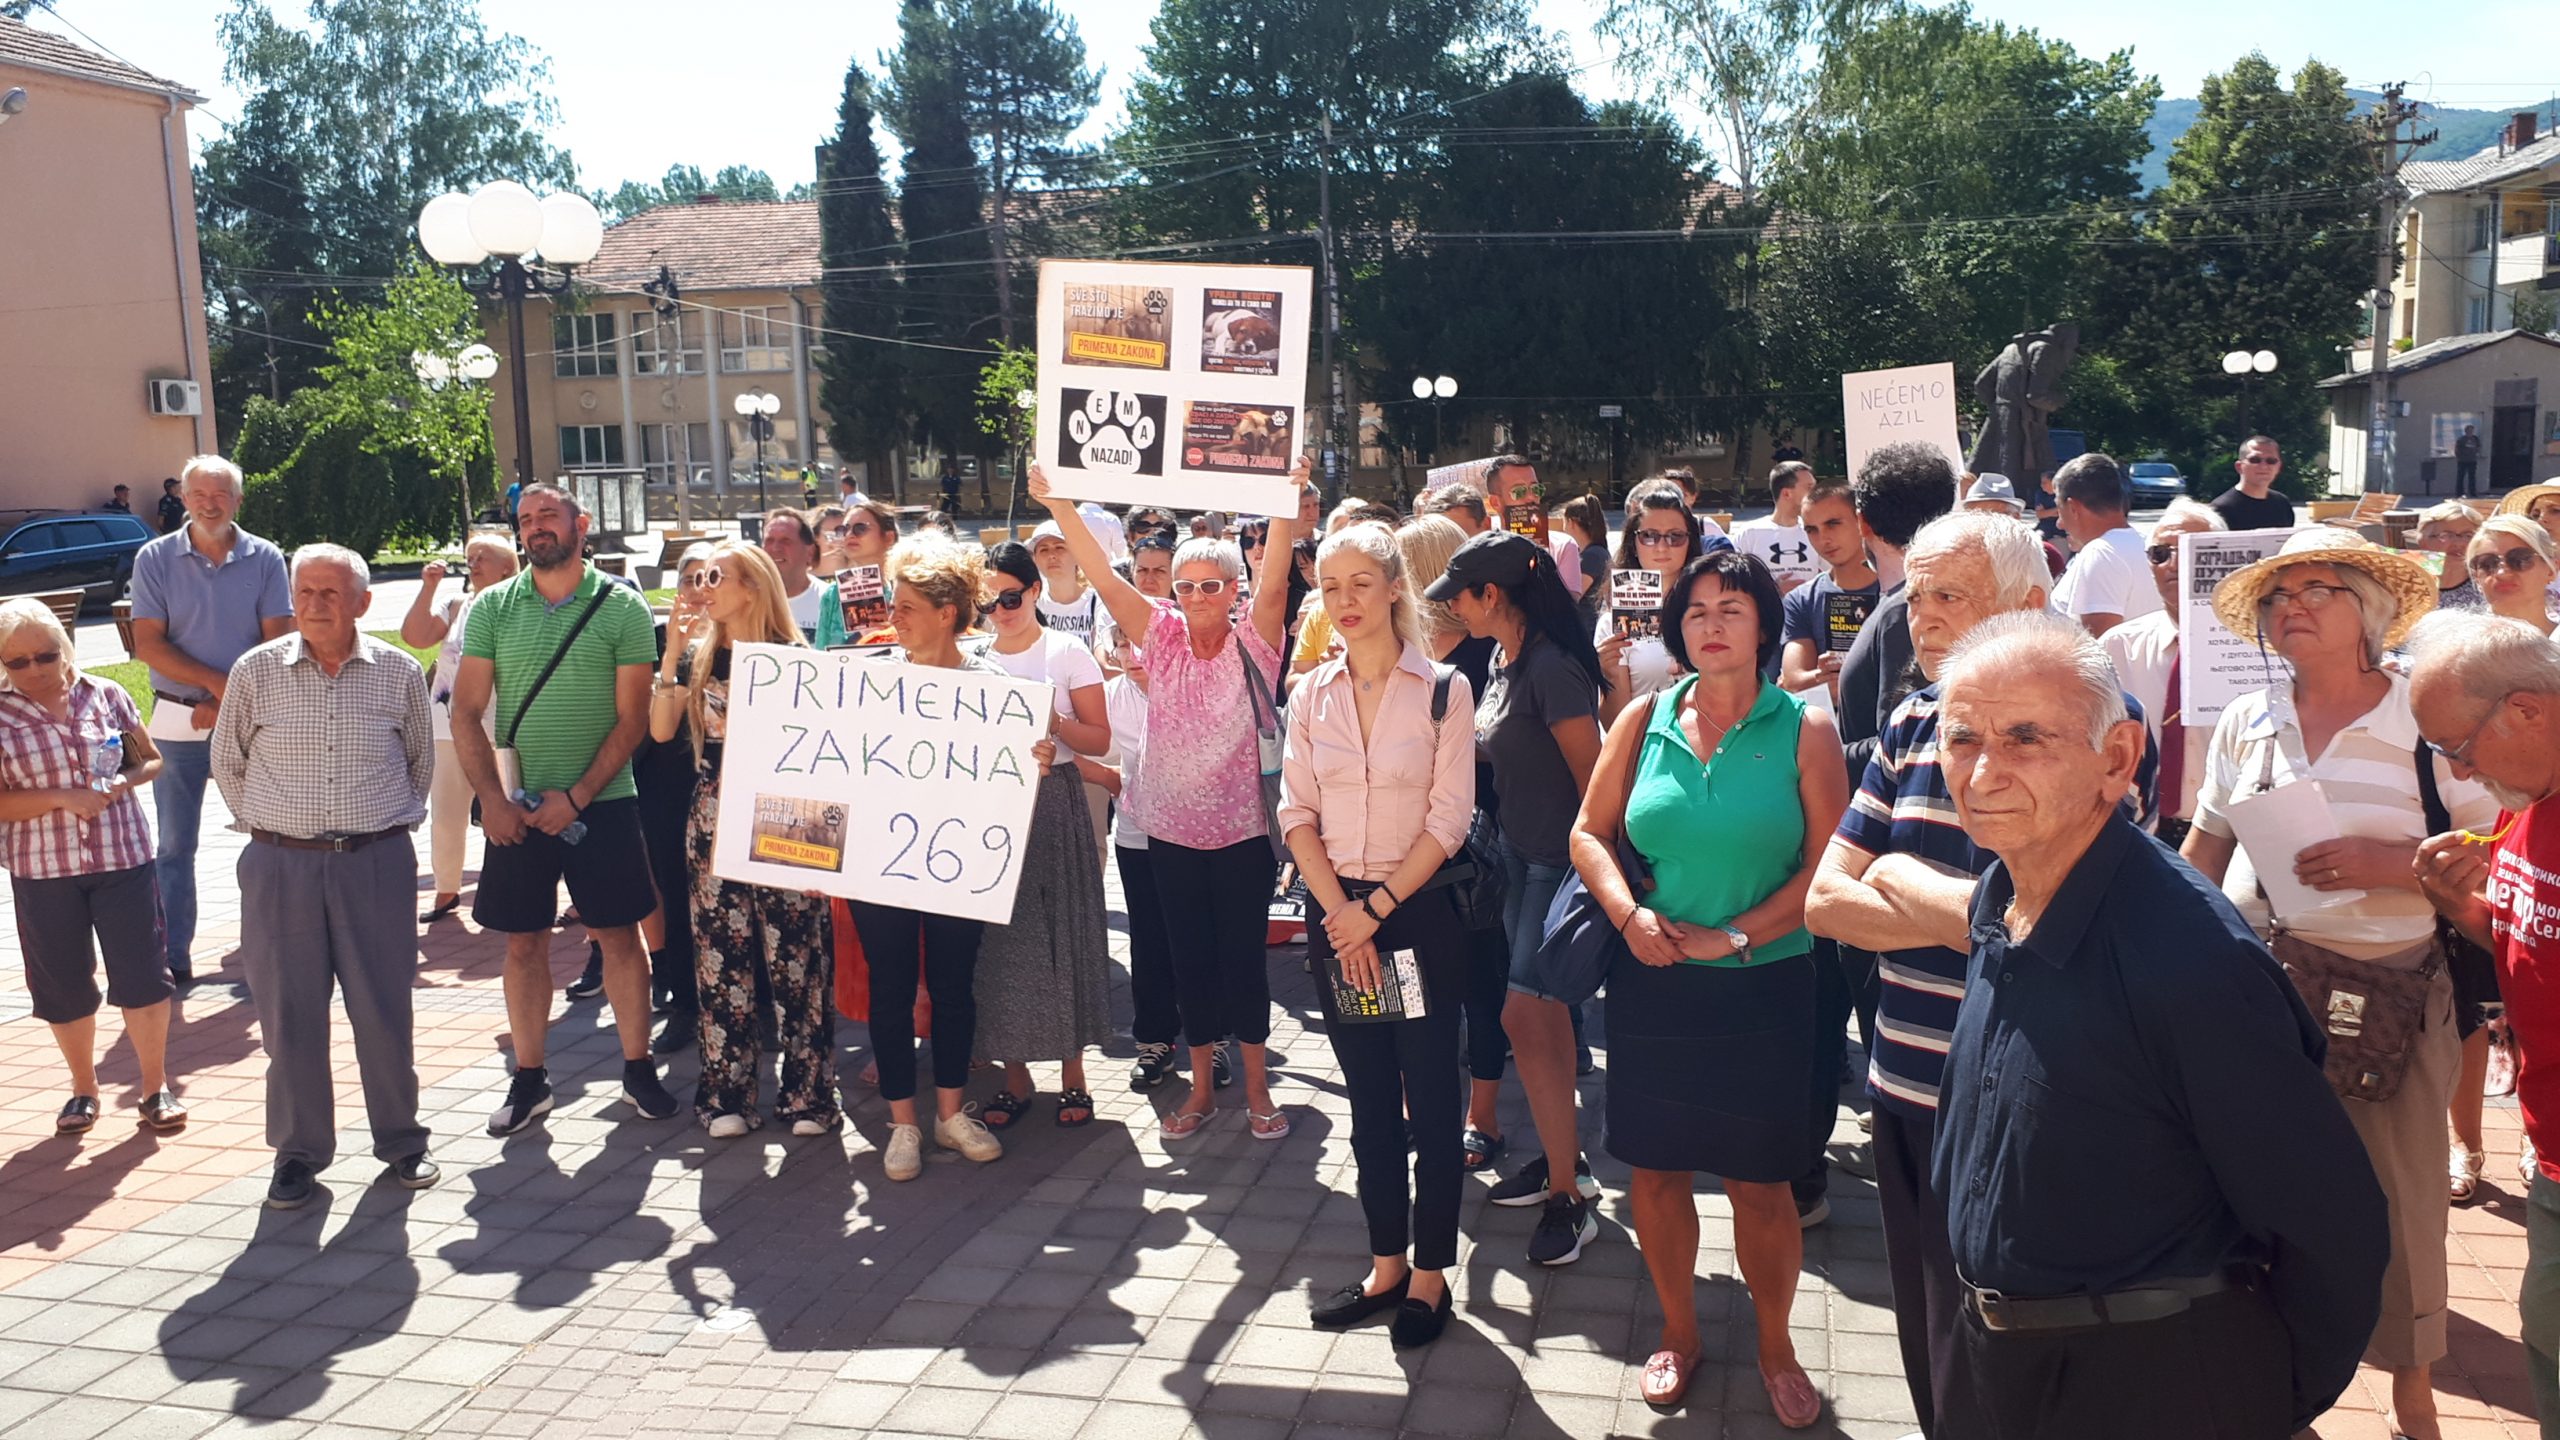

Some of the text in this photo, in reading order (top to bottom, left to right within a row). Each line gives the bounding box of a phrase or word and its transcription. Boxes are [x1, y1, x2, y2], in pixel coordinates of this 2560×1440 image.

[1113, 307, 1124, 319] JE
[1078, 339, 1156, 360] PRIMENA ZAKONA
[1860, 379, 1945, 411] NEĆEMO
[1879, 409, 1925, 429] AZIL
[1091, 447, 1133, 465] NAZAD!
[1051, 614, 1092, 631] RUSSIAN
[774, 724, 1025, 787] ZAKONA
[764, 840, 830, 863] PRIMENA ZAKONA
[881, 813, 1012, 894] 269
[1340, 990, 1352, 1015] LOGOR
[1359, 996, 1370, 1016] NIJE
